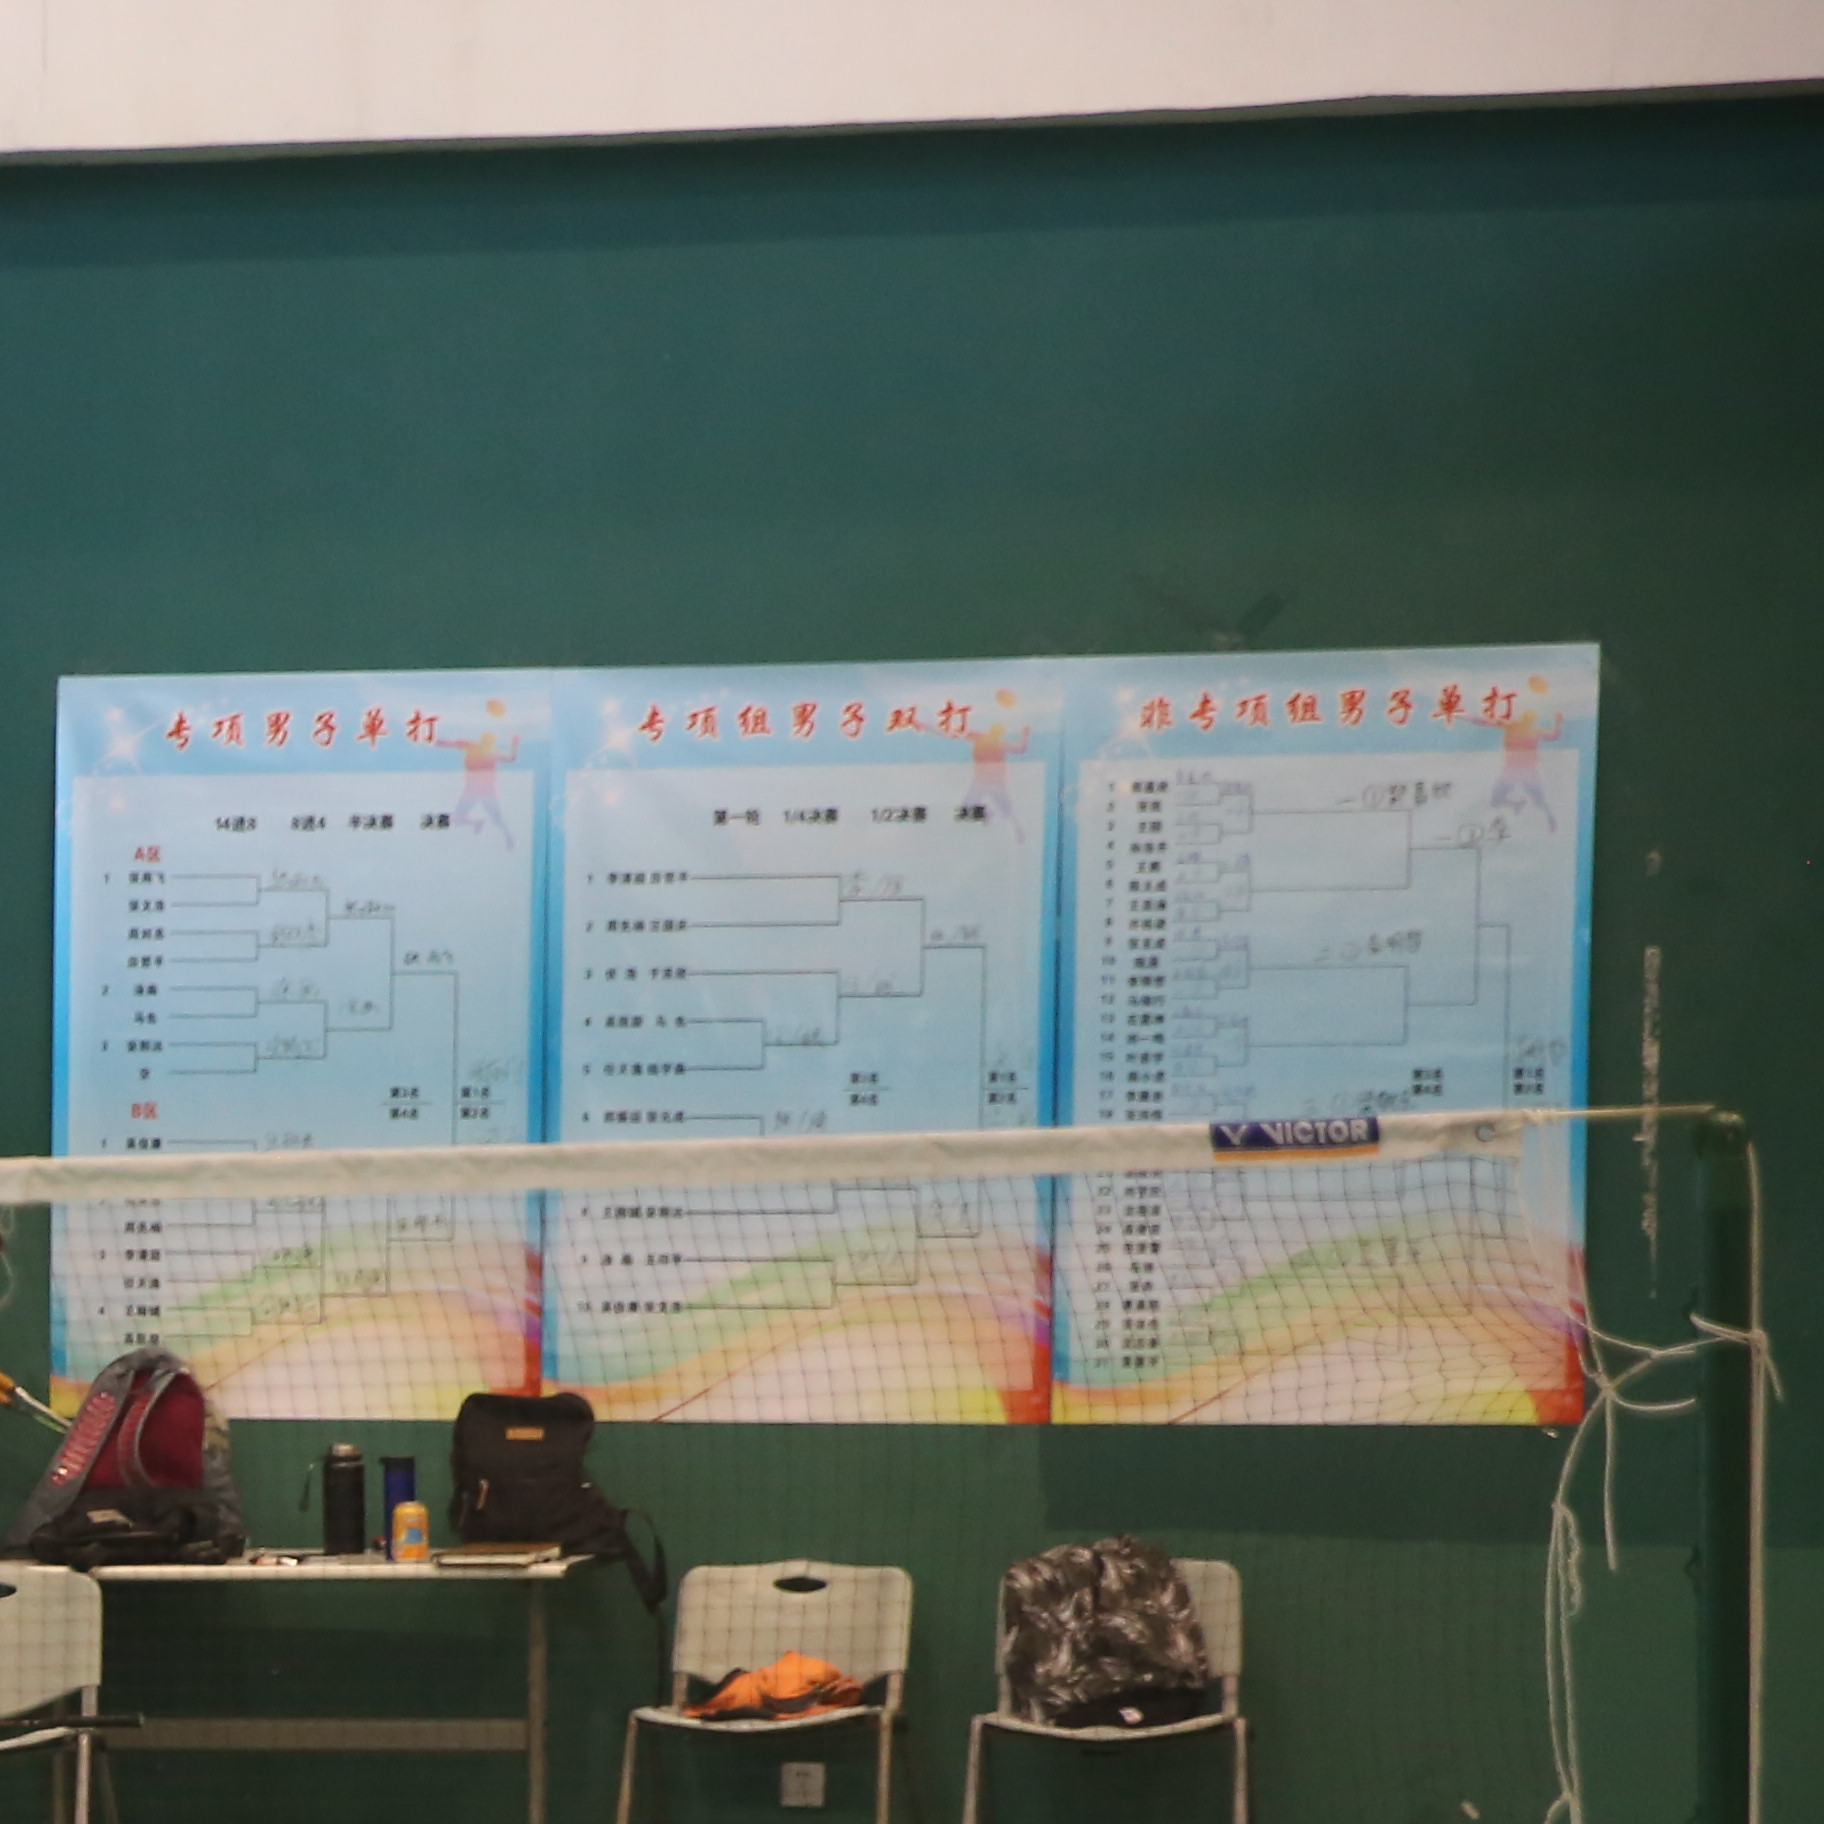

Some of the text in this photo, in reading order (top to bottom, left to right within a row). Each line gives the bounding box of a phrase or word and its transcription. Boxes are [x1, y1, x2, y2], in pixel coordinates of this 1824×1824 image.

[638, 702, 974, 742] 专项组男子双打
[1139, 684, 1519, 730] 非专项组男子单打
[165, 709, 440, 750] 专项男子单打
[348, 814, 394, 831] 半决赛
[420, 813, 451, 830] 决赛
[713, 805, 986, 827] 第一轮 1/4决赛 1/2决赛 决赛
[1259, 1119, 1369, 1145] VICTOR
